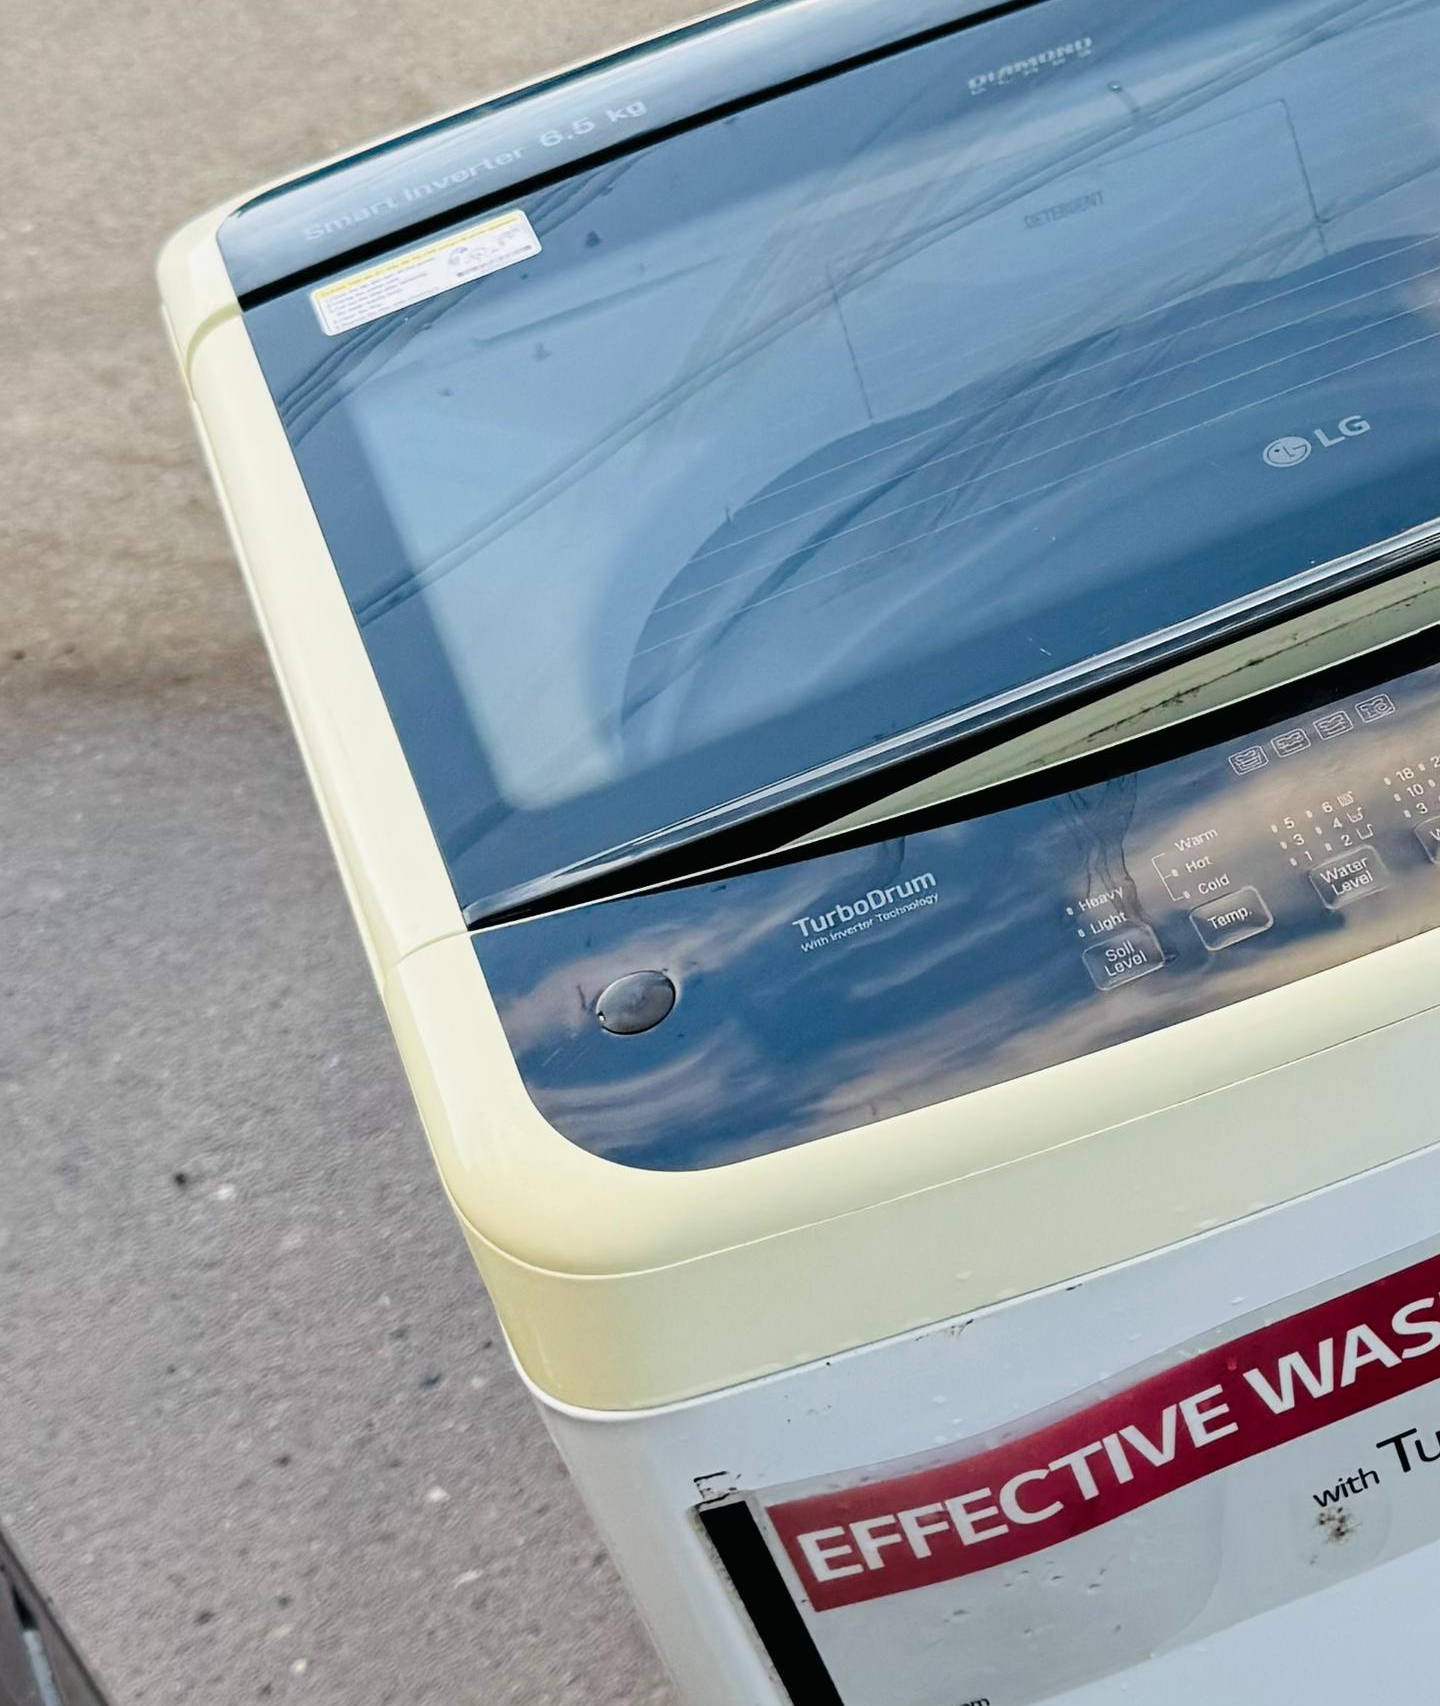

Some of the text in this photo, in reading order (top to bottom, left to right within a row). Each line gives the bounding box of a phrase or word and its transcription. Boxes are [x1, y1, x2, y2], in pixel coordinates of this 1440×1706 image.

[303, 193, 402, 243] Smart
[538, 116, 597, 149] 6.5
[605, 98, 649, 125] kg
[1313, 415, 1371, 448] LG
[1396, 767, 1415, 783] 18
[1406, 783, 1425, 798] 10
[1284, 801, 1334, 830] 5 6
[1416, 802, 1428, 815] 3
[1174, 828, 1219, 853] Warm
[1293, 817, 1343, 846] 3 4
[1304, 834, 1353, 862] 1 2
[1185, 855, 1212, 874] Hot
[1320, 856, 1369, 885] Water
[1198, 873, 1230, 895] Cold
[1331, 870, 1374, 897] Level
[792, 872, 937, 938] TurboDrum
[1078, 886, 1124, 912] Heavy
[1089, 910, 1128, 935] Light
[1208, 906, 1253, 931] Temp.
[800, 936, 829, 953] With
[830, 918, 874, 941] Inverter
[1104, 949, 1147, 977] Level
[1105, 940, 1136, 963] Soil
[797, 1385, 1240, 1585] EFFECTIVE
[1311, 1464, 1381, 1509] with
